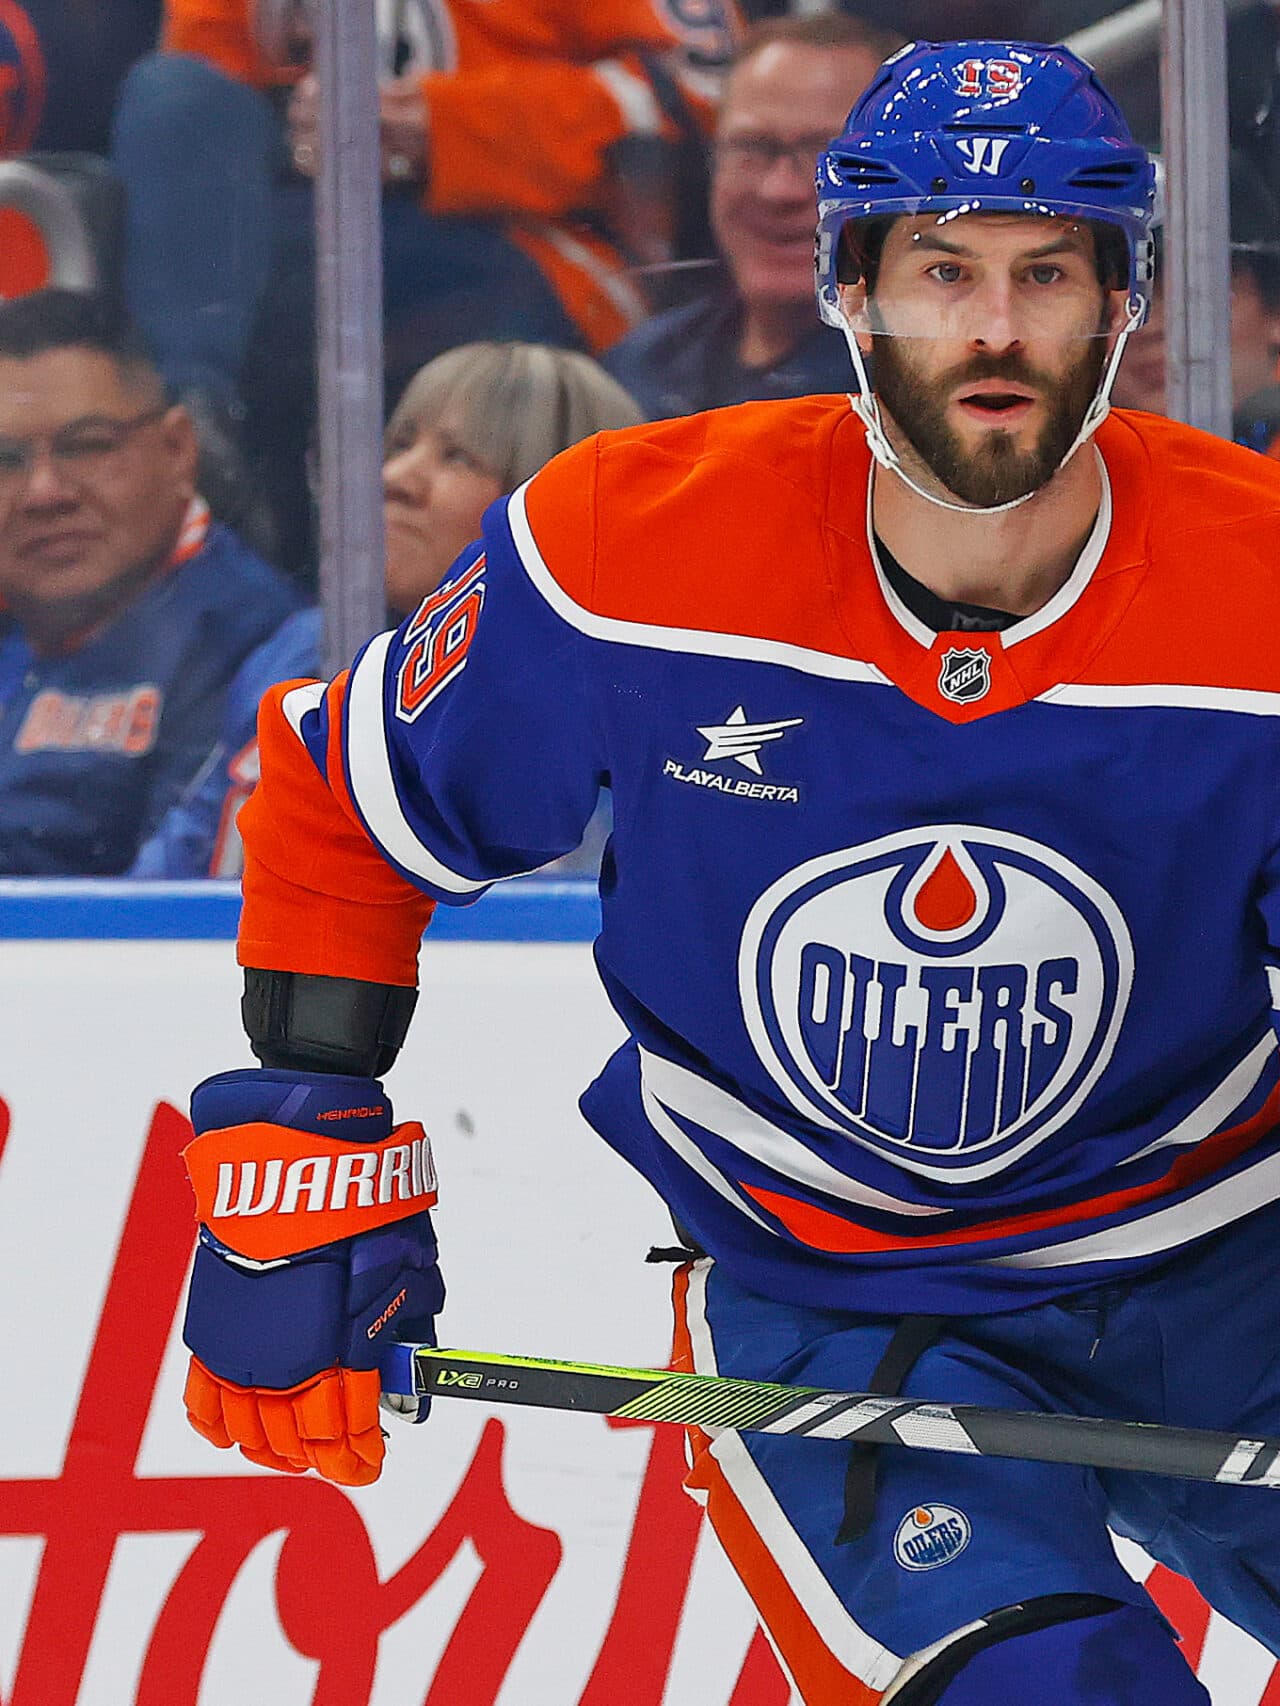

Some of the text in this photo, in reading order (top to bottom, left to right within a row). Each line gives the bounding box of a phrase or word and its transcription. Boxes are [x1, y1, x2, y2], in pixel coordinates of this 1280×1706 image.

[953, 58, 1022, 98] 19
[395, 551, 487, 724] 19
[948, 662, 982, 692] NHL
[797, 941, 1080, 1151] OILERS
[367, 1288, 407, 1339] COVERT
[486, 1378, 519, 1389] PRO
[902, 1516, 964, 1565] OILERS
